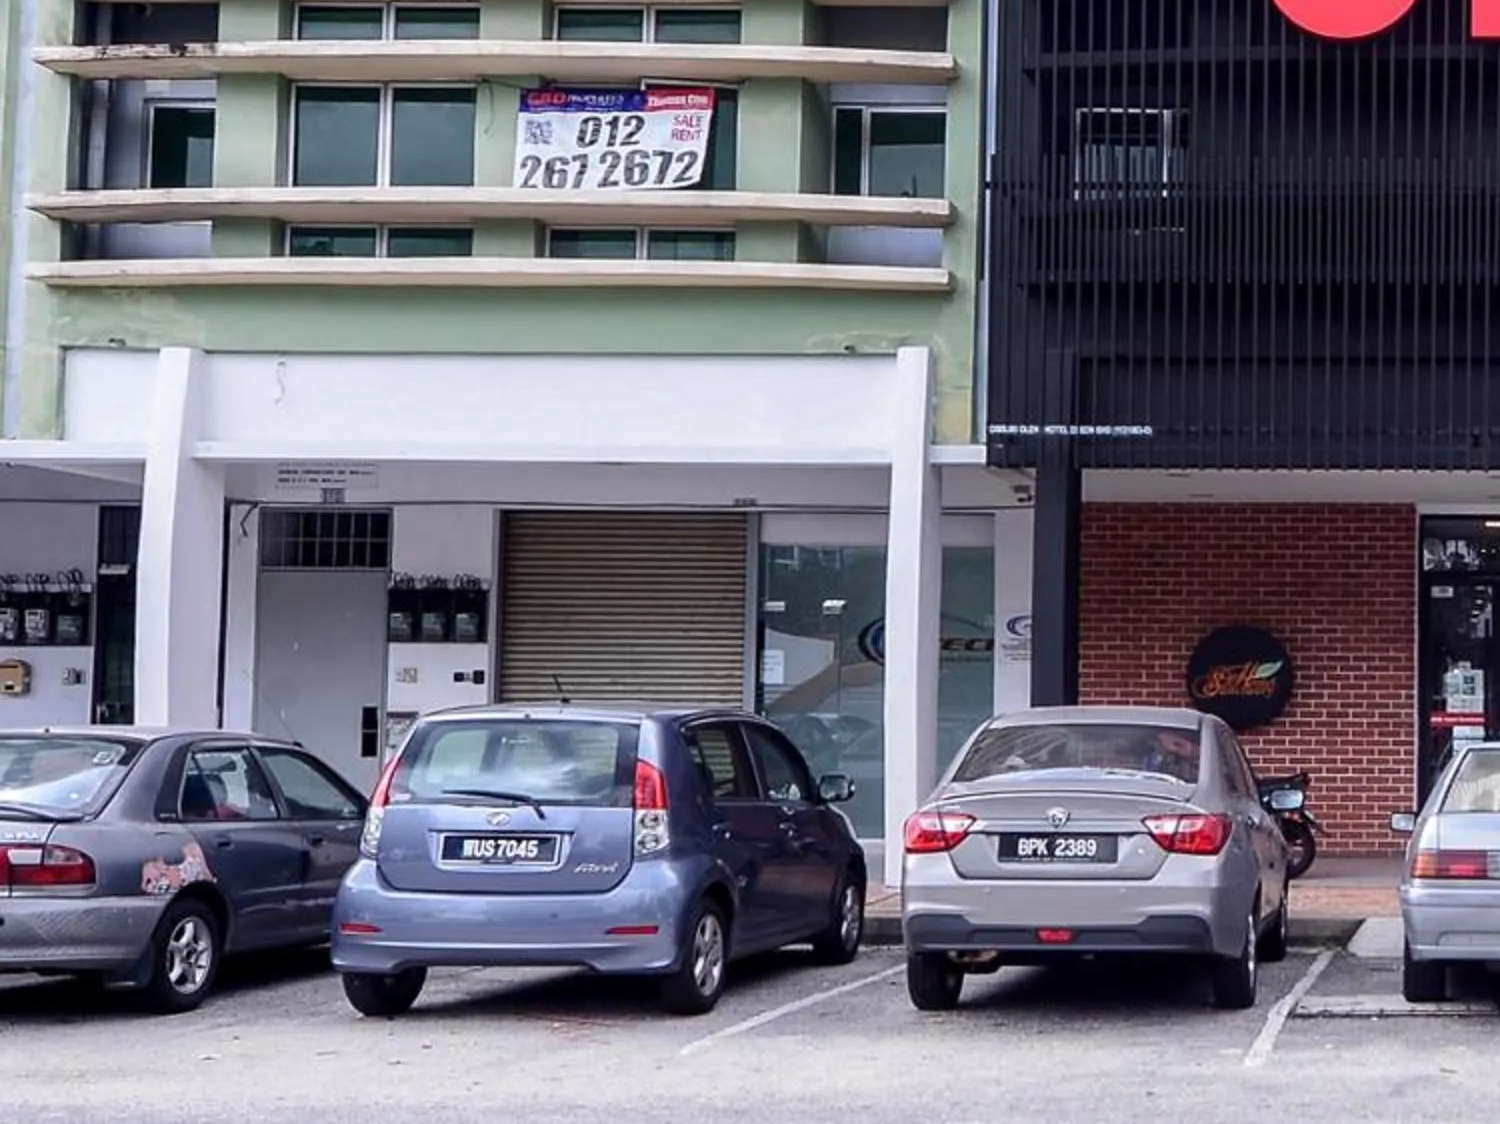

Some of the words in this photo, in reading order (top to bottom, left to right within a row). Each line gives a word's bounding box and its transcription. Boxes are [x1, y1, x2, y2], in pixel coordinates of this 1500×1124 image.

[576, 115, 645, 149] 012
[520, 154, 589, 189] 267
[597, 149, 699, 188] 2672
[1054, 839, 1097, 857] 2389
